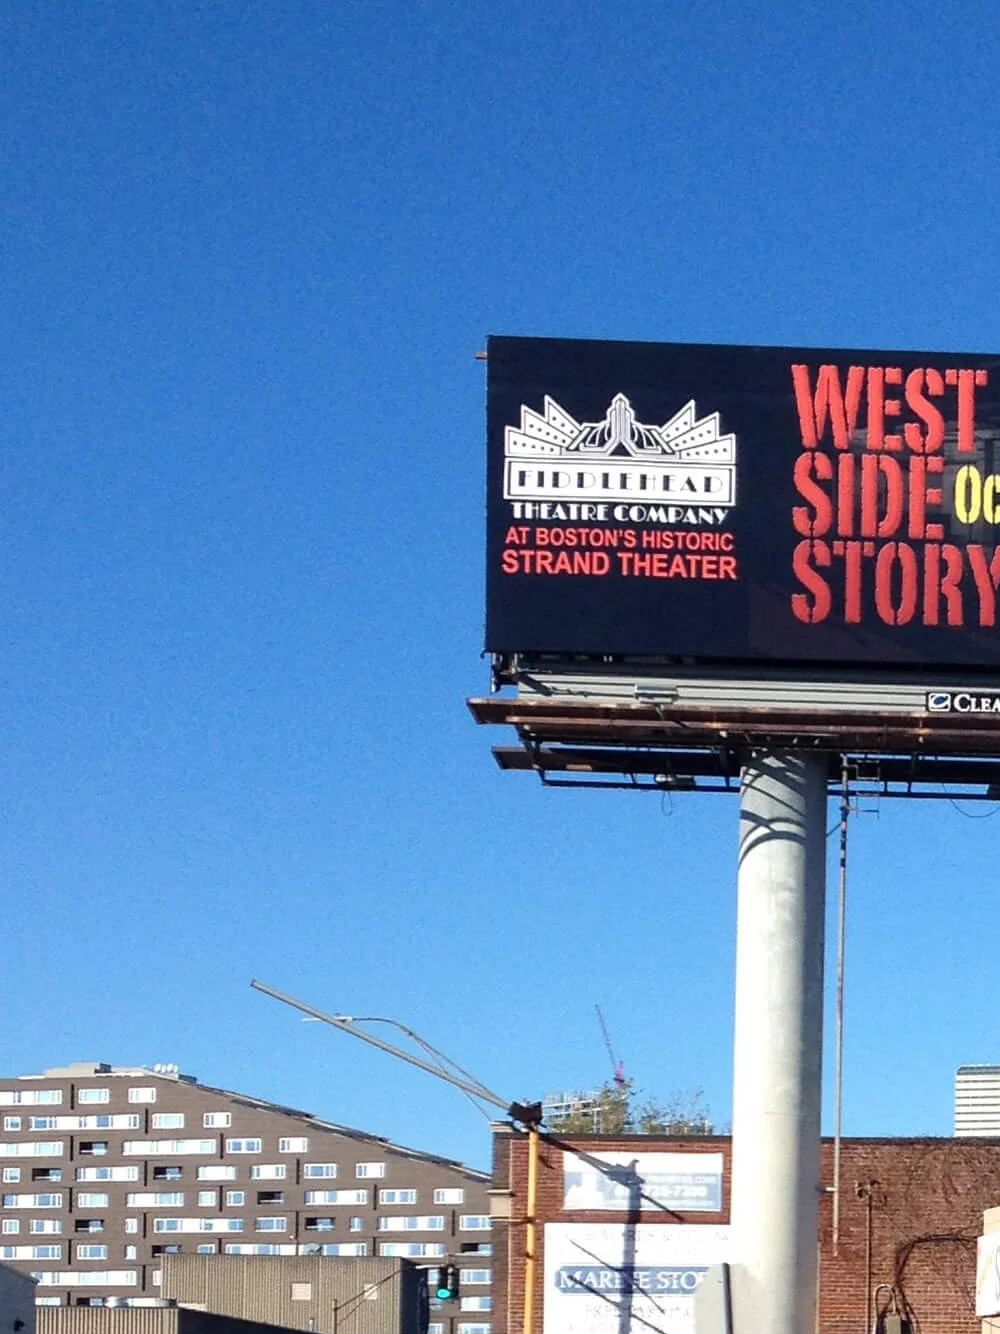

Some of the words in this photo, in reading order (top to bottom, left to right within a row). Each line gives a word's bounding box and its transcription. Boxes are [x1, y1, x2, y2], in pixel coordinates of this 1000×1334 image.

[791, 364, 988, 454] WEST
[517, 469, 724, 493] FIDDLEHEAD
[792, 451, 944, 540] SIDE
[510, 502, 609, 521] THEATRE
[613, 504, 729, 525] COMPANY
[505, 526, 530, 544] AT
[535, 527, 637, 549] BOSTON'S
[642, 530, 734, 551] HISTORIC
[502, 549, 610, 576] STRAND
[617, 551, 737, 580] THEATER
[559, 1270, 652, 1290] MARINE
